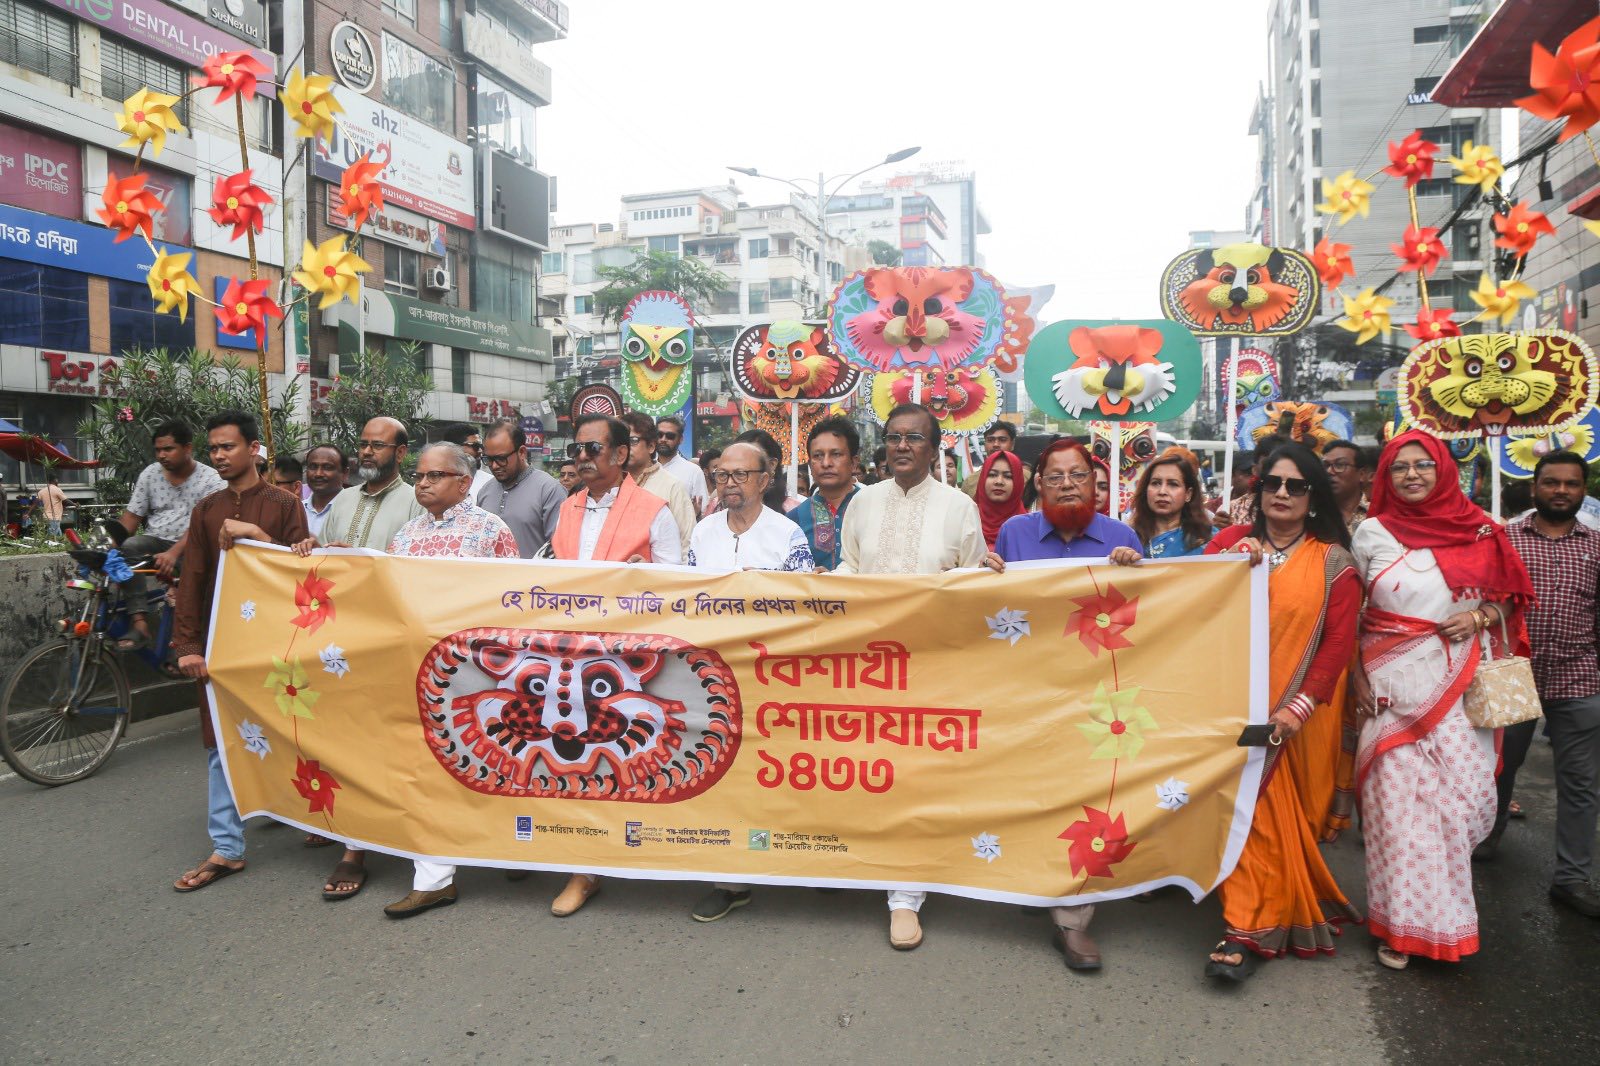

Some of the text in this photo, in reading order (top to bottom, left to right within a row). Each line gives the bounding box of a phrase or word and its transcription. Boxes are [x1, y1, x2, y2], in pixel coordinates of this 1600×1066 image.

[122, 3, 189, 47] DENTAL
[211, 7, 258, 38] SusNex Ltd
[336, 51, 373, 75] SOUTH POLE
[372, 110, 399, 136] ahz
[366, 138, 375, 146] THE
[24, 153, 68, 181] IPDC
[25, 172, 69, 195] ডিপোজিট
[0, 222, 78, 256] াংক এশিয়া
[48, 380, 96, 395] Fabrics
[502, 585, 847, 618] হে চিরনূতন, আজি এ দিনের প্রথম গানে
[748, 640, 911, 691] বৈশাখী
[756, 702, 982, 752] শোভাযাত্রা
[756, 750, 894, 794] ১৪৩৩
[813, 844, 848, 853] টেকনোলজি
